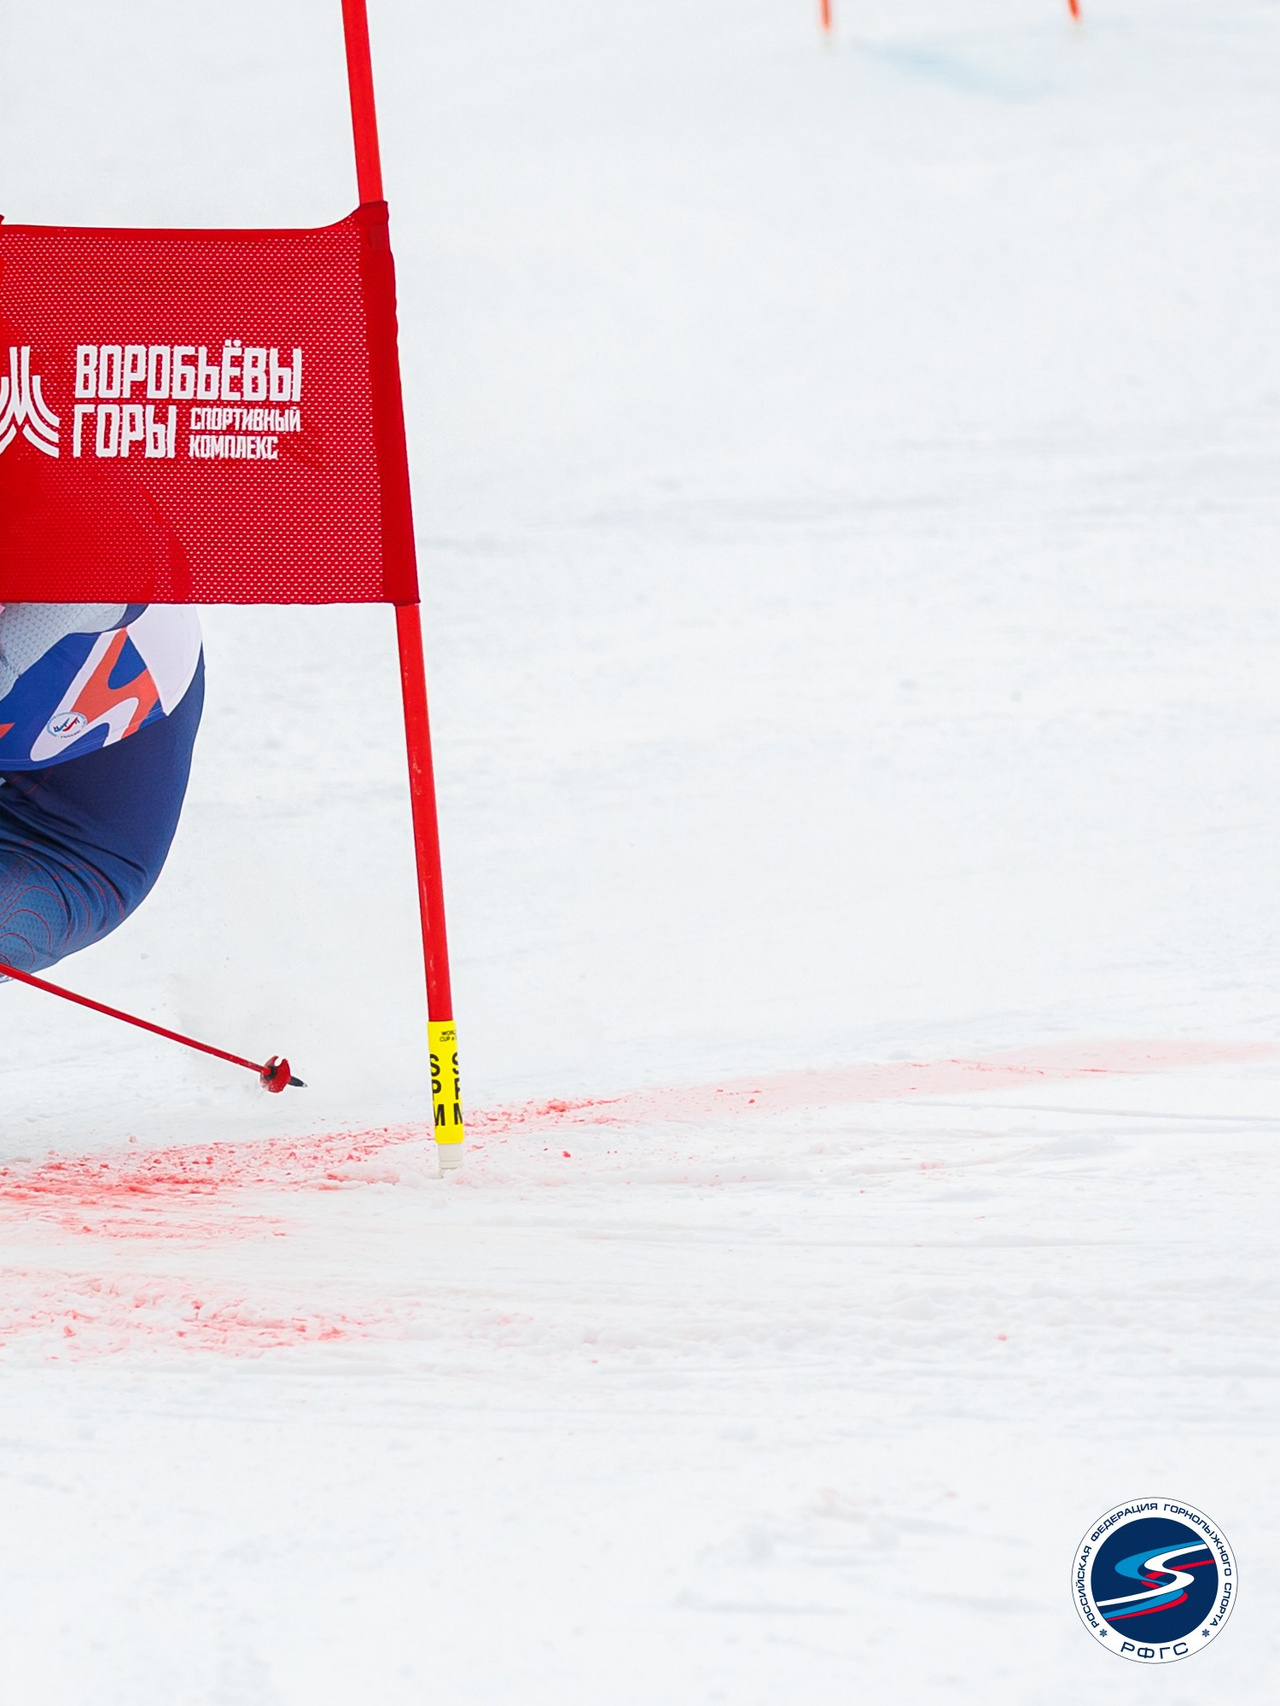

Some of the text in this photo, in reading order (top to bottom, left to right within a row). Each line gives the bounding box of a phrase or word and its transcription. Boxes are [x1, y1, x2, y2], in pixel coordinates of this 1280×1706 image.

[74, 339, 303, 402] ВОРОБЬЁВЫ
[73, 404, 177, 459] ГОРЫ
[190, 406, 302, 432] СПОРТИВНЫЙ
[189, 435, 279, 459] КОМПЛЕКС
